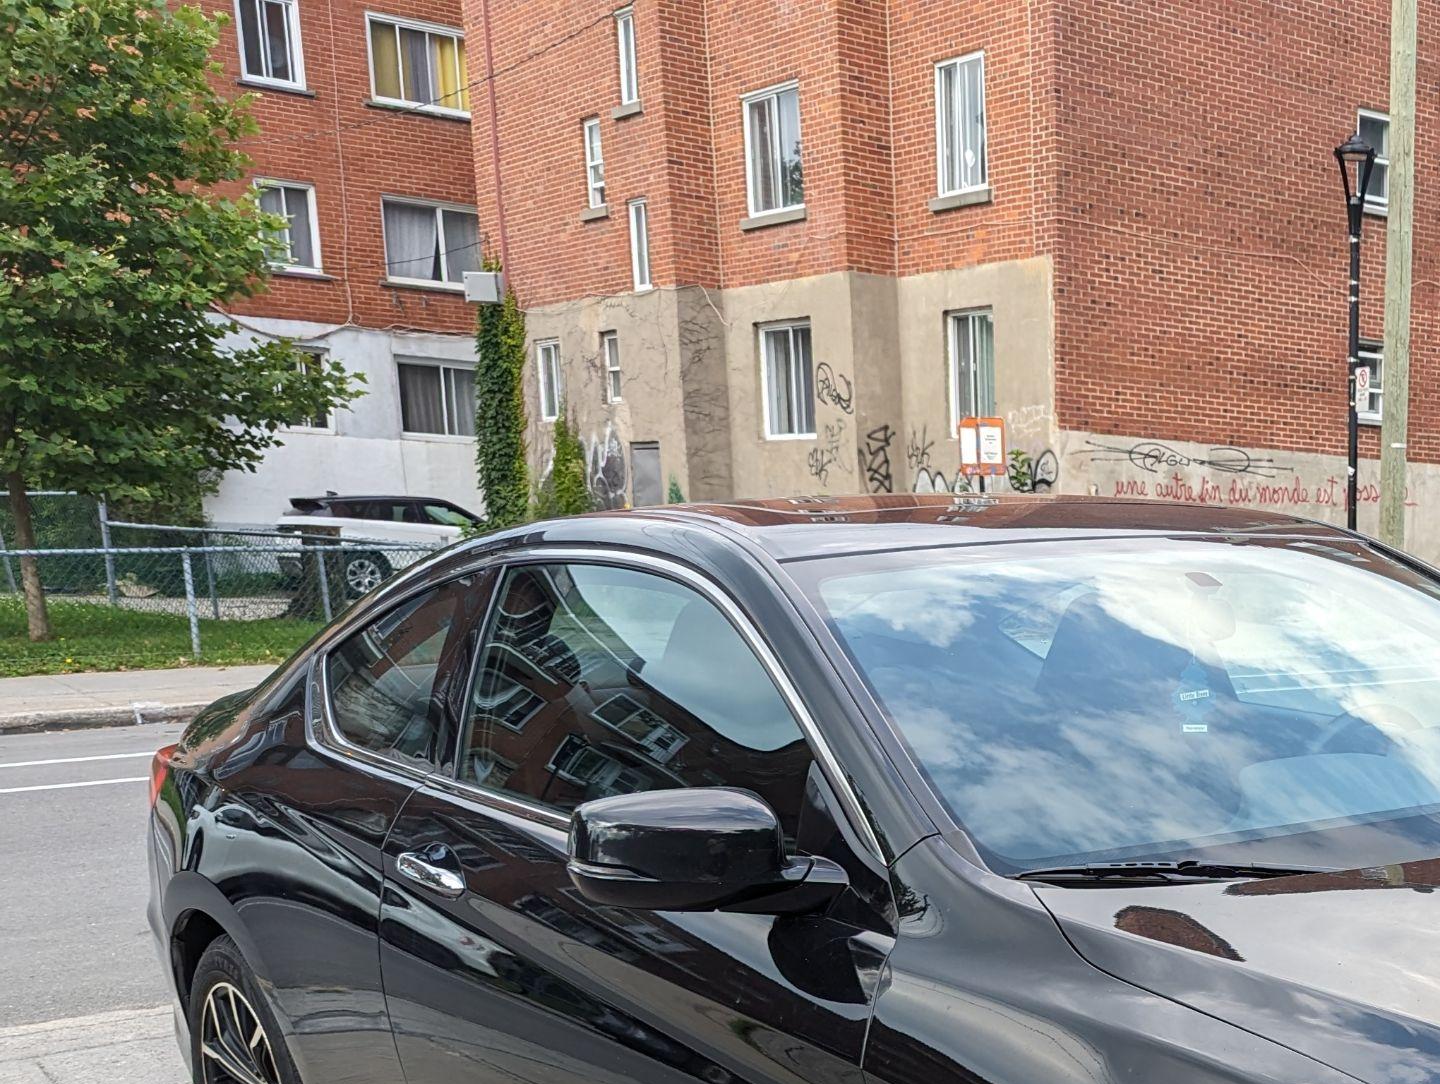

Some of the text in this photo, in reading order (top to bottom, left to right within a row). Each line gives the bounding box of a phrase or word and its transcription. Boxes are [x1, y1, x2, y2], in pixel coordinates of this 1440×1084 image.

[1114, 479, 1149, 497] une
[1155, 472, 1197, 502] autre
[1228, 479, 1252, 504] du
[1255, 476, 1310, 505] monde
[1315, 475, 1338, 506] est
